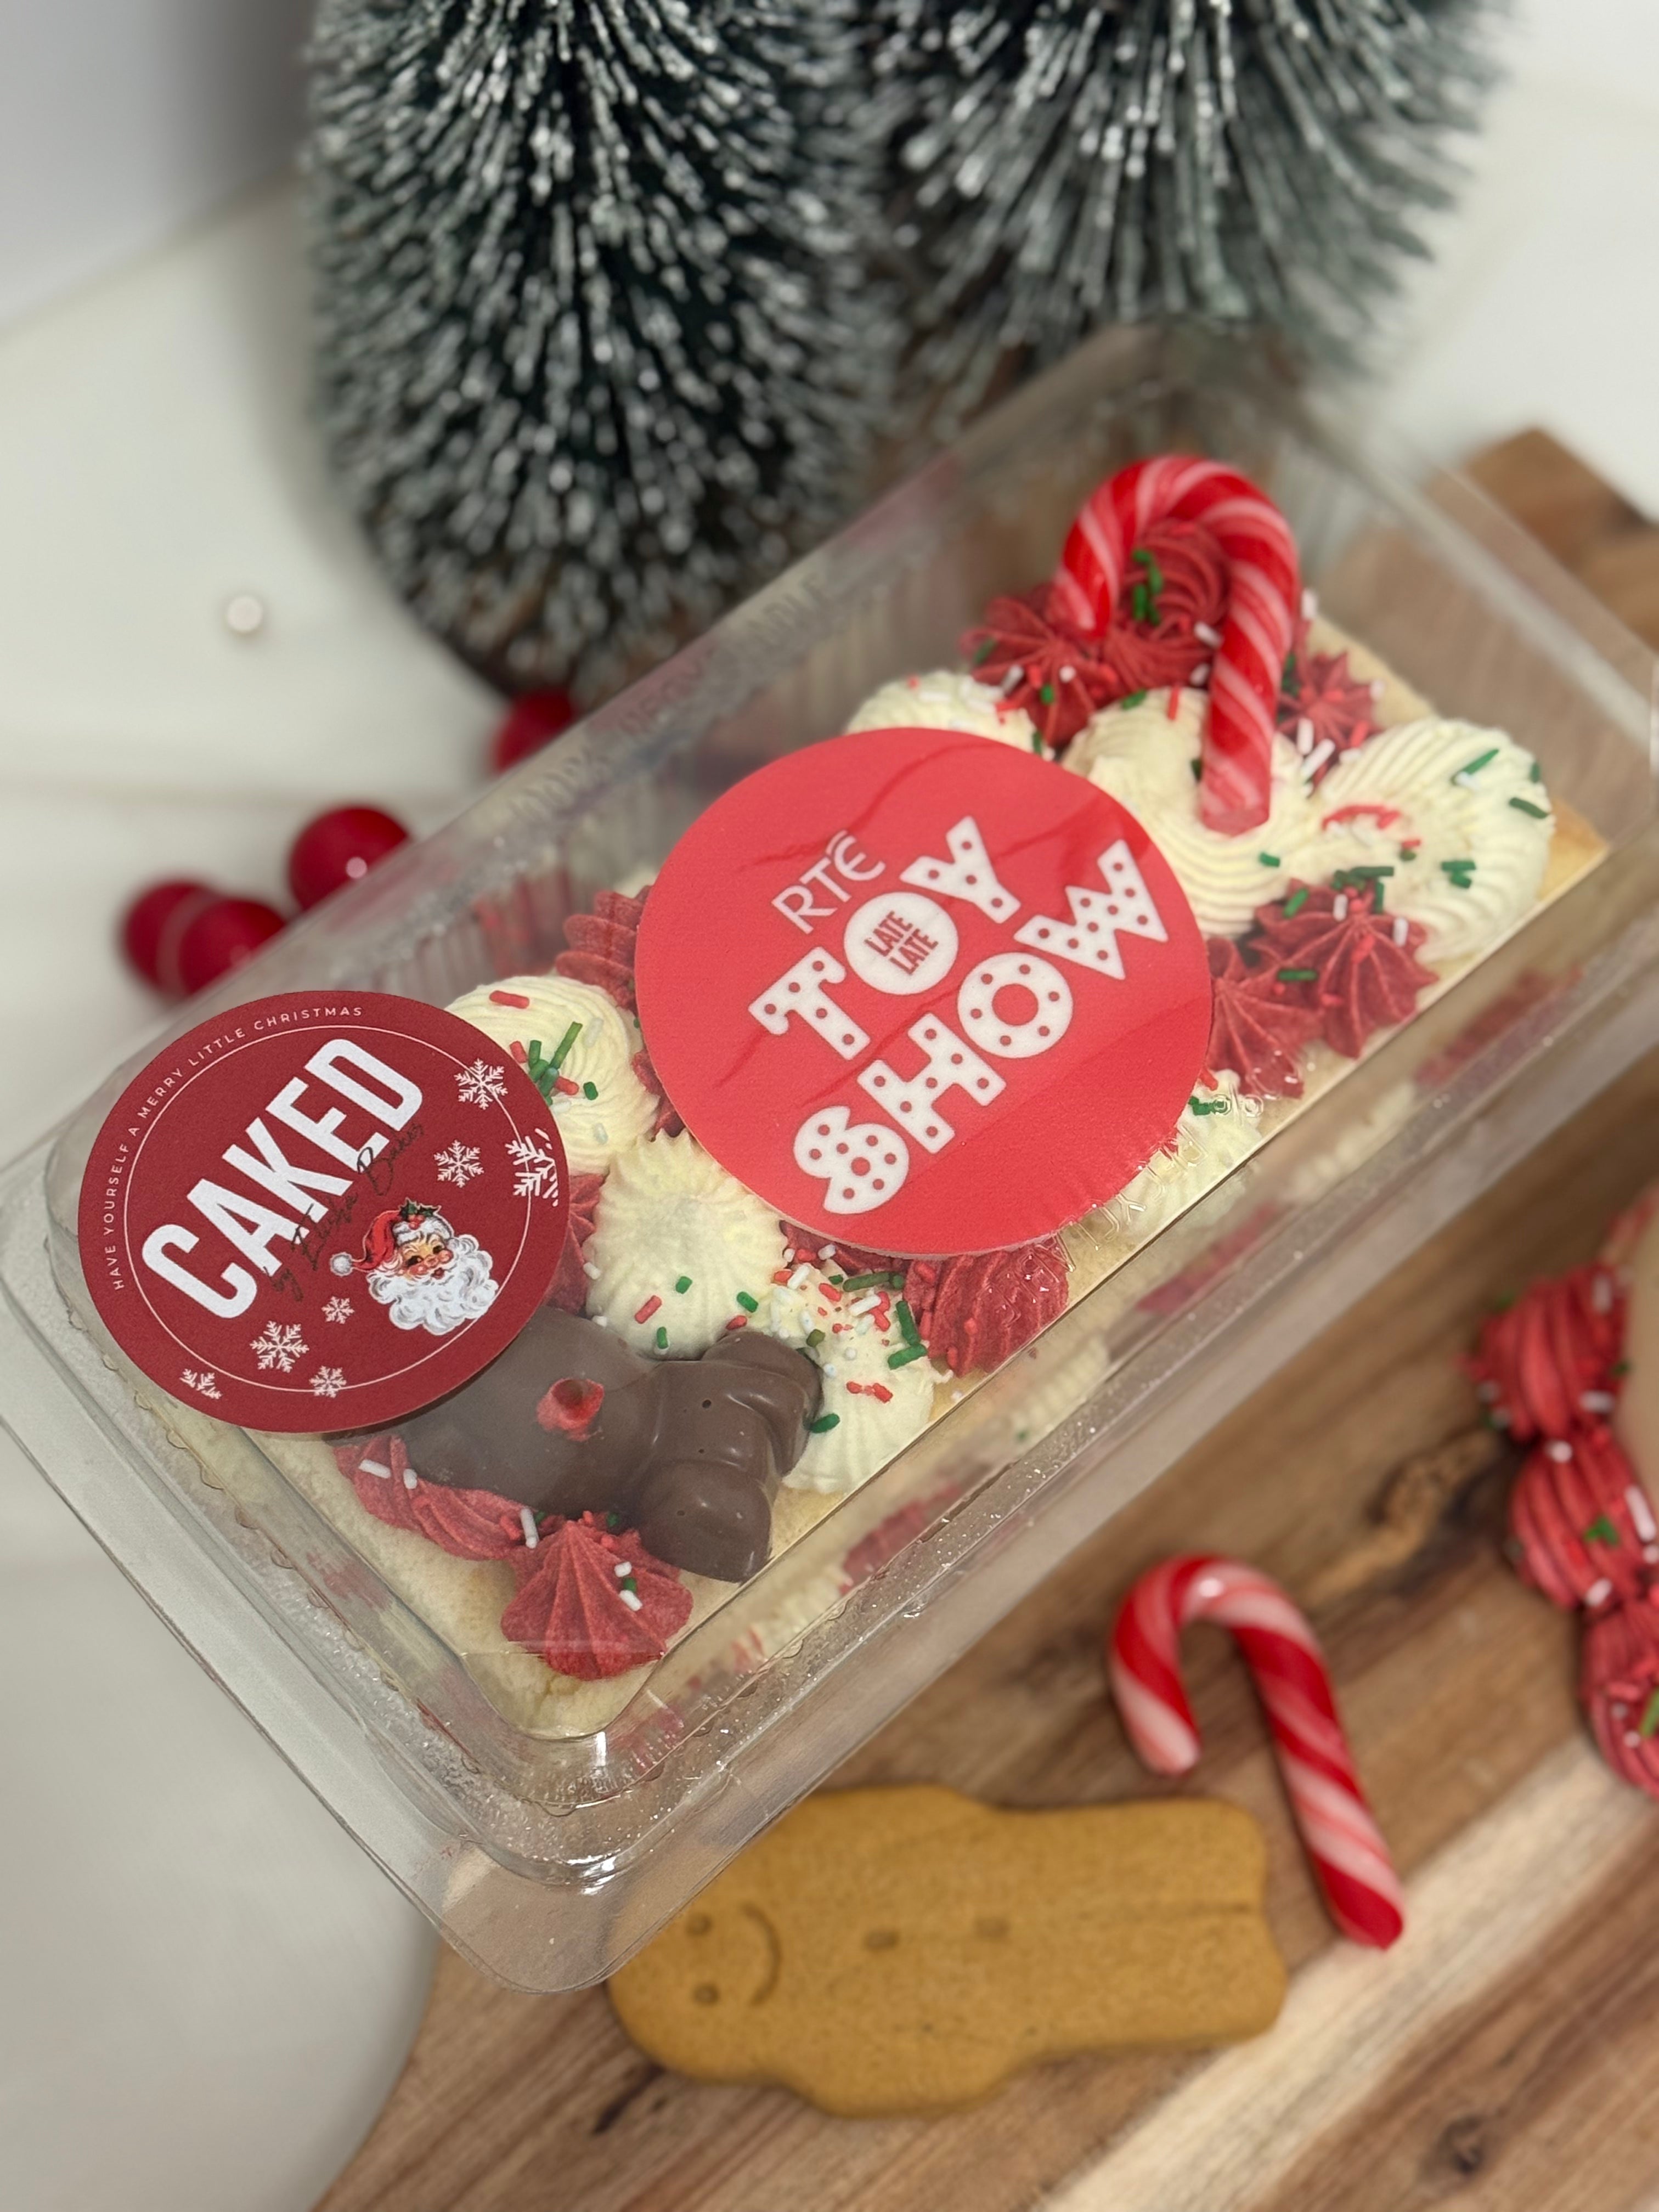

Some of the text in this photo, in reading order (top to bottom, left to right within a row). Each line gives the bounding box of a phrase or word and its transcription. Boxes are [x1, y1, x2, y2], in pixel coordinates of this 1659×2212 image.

[748, 815, 1021, 1061] TOY
[771, 830, 886, 935] RTÉ
[864, 910, 913, 957] LATE
[889, 928, 939, 975] LATE
[103, 1007, 363, 1290] HAVE YOURSELF A MERRY LITTLE CHRISTMAS
[793, 839, 1169, 1214] SHOW
[142, 1039, 424, 1318] CAKED
